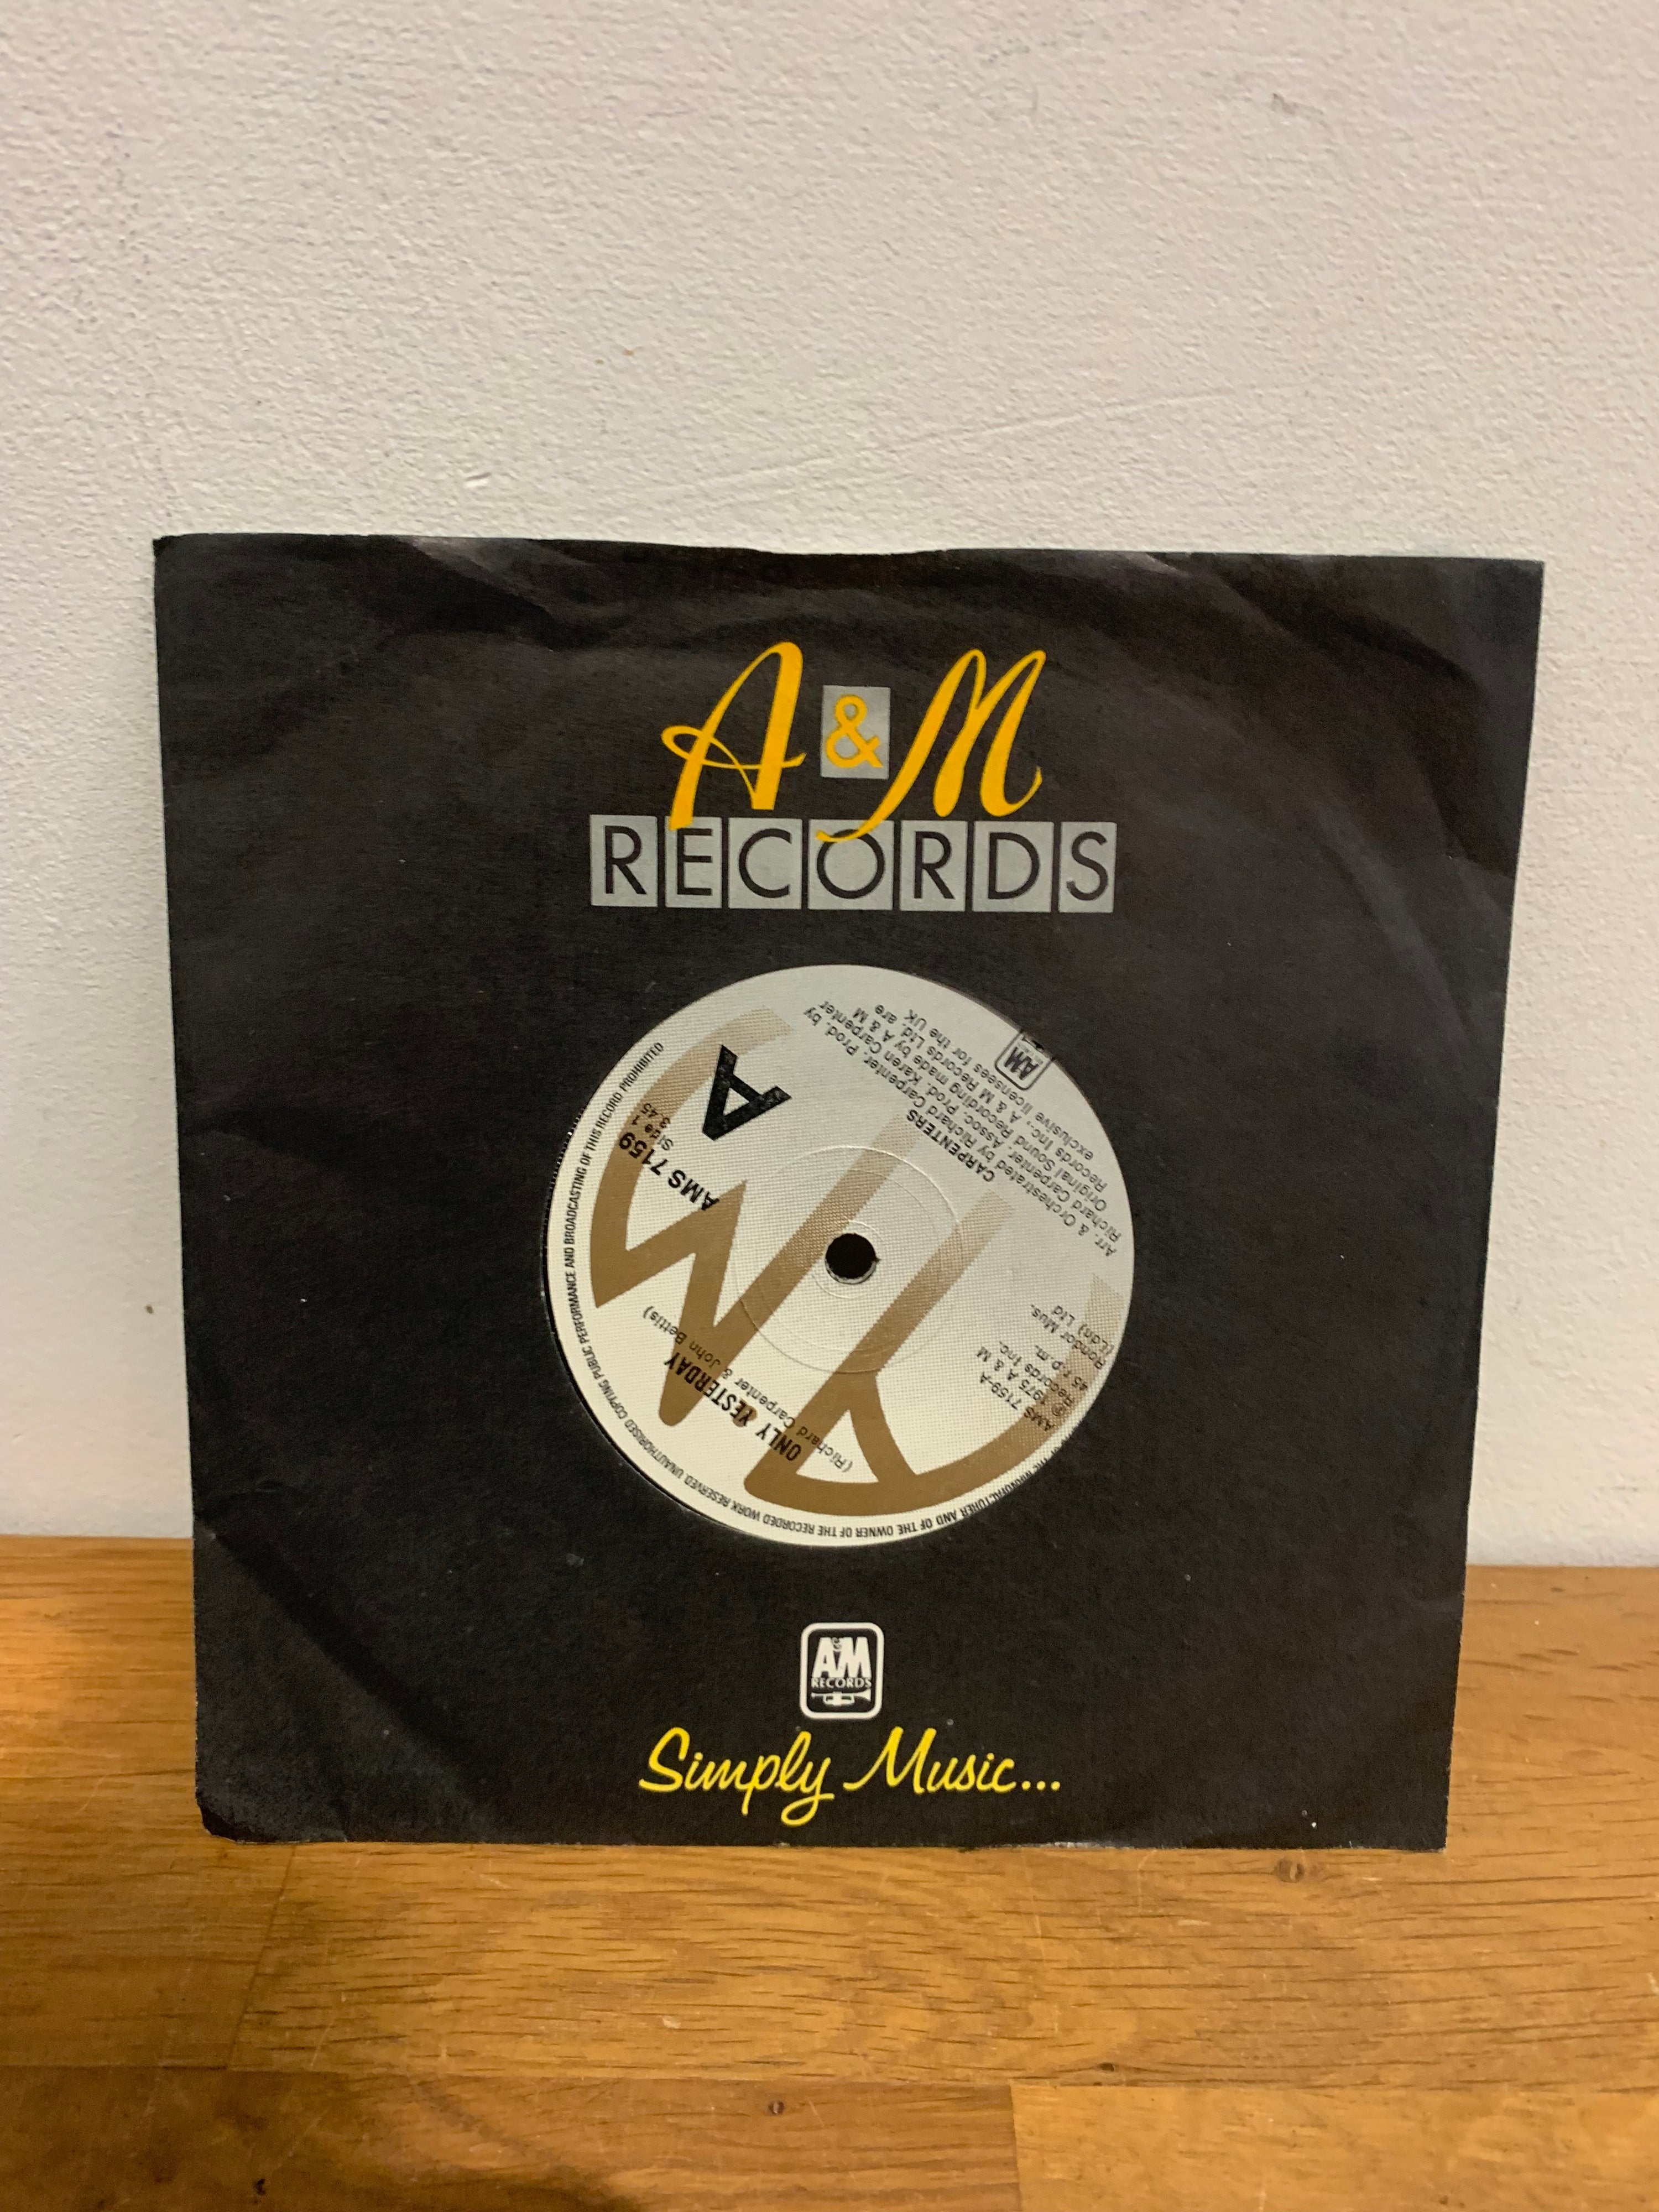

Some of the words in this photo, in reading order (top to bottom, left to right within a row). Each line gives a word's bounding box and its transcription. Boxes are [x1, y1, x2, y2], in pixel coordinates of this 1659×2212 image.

[602, 824, 1110, 903] RECORDS
[801, 1004, 825, 1027] by
[816, 997, 885, 1056] Carpenter
[851, 1006, 870, 1025] M
[867, 1019, 882, 1034] &
[872, 1002, 898, 1026] are
[902, 1008, 928, 1032] UK
[820, 1021, 860, 1057] Prod.
[879, 1028, 896, 1045] A
[891, 1036, 915, 1059] by
[895, 1022, 926, 1050] Ltd.
[925, 1026, 952, 1050] the
[617, 1040, 665, 1092] PROHIBITED
[880, 1048, 923, 1087] Karen
[909, 1052, 950, 1088] made
[922, 1044, 980, 1093] Records
[950, 1046, 973, 1067] for
[702, 1043, 792, 1141] A
[857, 1050, 928, 1110] Carpenter.
[971, 1062, 1034, 1115] licensees
[977, 1087, 995, 1105] M
[594, 1090, 623, 1129] RECORD
[921, 1081, 961, 1116] Prod.
[946, 1081, 1015, 1140] Recording
[993, 1099, 1008, 1115] &
[924, 1103, 978, 1150] Richard
[957, 1109, 1005, 1151] Assoc.
[1006, 1109, 1022, 1126] A
[583, 1127, 602, 1152] THIS
[615, 1128, 670, 1177] 7159
[904, 1107, 997, 1184] CARPENTERS
[974, 1142, 998, 1164] by
[1011, 1133, 1057, 1173] Sound
[1031, 1110, 1094, 1164] exclusive
[578, 1151, 592, 1166] OF
[1001, 1144, 1073, 1204] Carpenter.
[1052, 1145, 1108, 1193] Records
[564, 1166, 587, 1244] BROADCASTING
[664, 1165, 720, 1215] AMS
[993, 1157, 1078, 1228] Orchestrated
[1053, 1165, 1109, 1213] Original
[1069, 1197, 1123, 1244] Richard
[1076, 1223, 1090, 1237] &
[564, 1247, 575, 1268] AND
[1088, 1233, 1116, 1258] Arr.
[565, 1271, 590, 1344] PERFORMANCE
[1025, 1302, 1060, 1334] Mus.
[1051, 1303, 1076, 1327] Ltd
[640, 1304, 688, 1347] Bettis)
[1075, 1321, 1115, 1357] (Ldn)
[581, 1344, 604, 1380] PUBLIC
[685, 1339, 722, 1372] John
[975, 1345, 993, 1363] M
[991, 1358, 1005, 1373] &
[993, 1339, 1023, 1367] Inc.
[1030, 1342, 1073, 1379] r.p.m.
[1058, 1328, 1107, 1370] Rondor
[662, 1347, 757, 1428] YESTERDAY
[720, 1366, 733, 1380] &
[976, 1370, 1024, 1411] 7159-A
[1004, 1368, 1020, 1384] A
[1022, 1361, 1077, 1408] Records
[1070, 1375, 1089, 1393] 45
[597, 1378, 629, 1420] COPYING
[732, 1374, 799, 1431] Carpenter
[1016, 1377, 1050, 1406] 1975
[1021, 1404, 1055, 1434] AMS
[623, 1417, 685, 1479] UNAUTHORISED
[754, 1418, 804, 1464] ONLY
[794, 1423, 854, 1475] (Richard
[729, 1500, 761, 1521] WORK
[761, 1512, 815, 1535] RECORDED
[897, 1521, 917, 1535] THE
[919, 1517, 933, 1530] OF
[935, 1509, 958, 1525] AND
[817, 1525, 837, 1536] THE
[839, 1527, 852, 1537] OF
[855, 1525, 894, 1537] OWNER
[811, 1677, 872, 1689] RECORDS
[639, 1726, 835, 1827] Simply
[843, 1726, 1061, 1796] Music...
